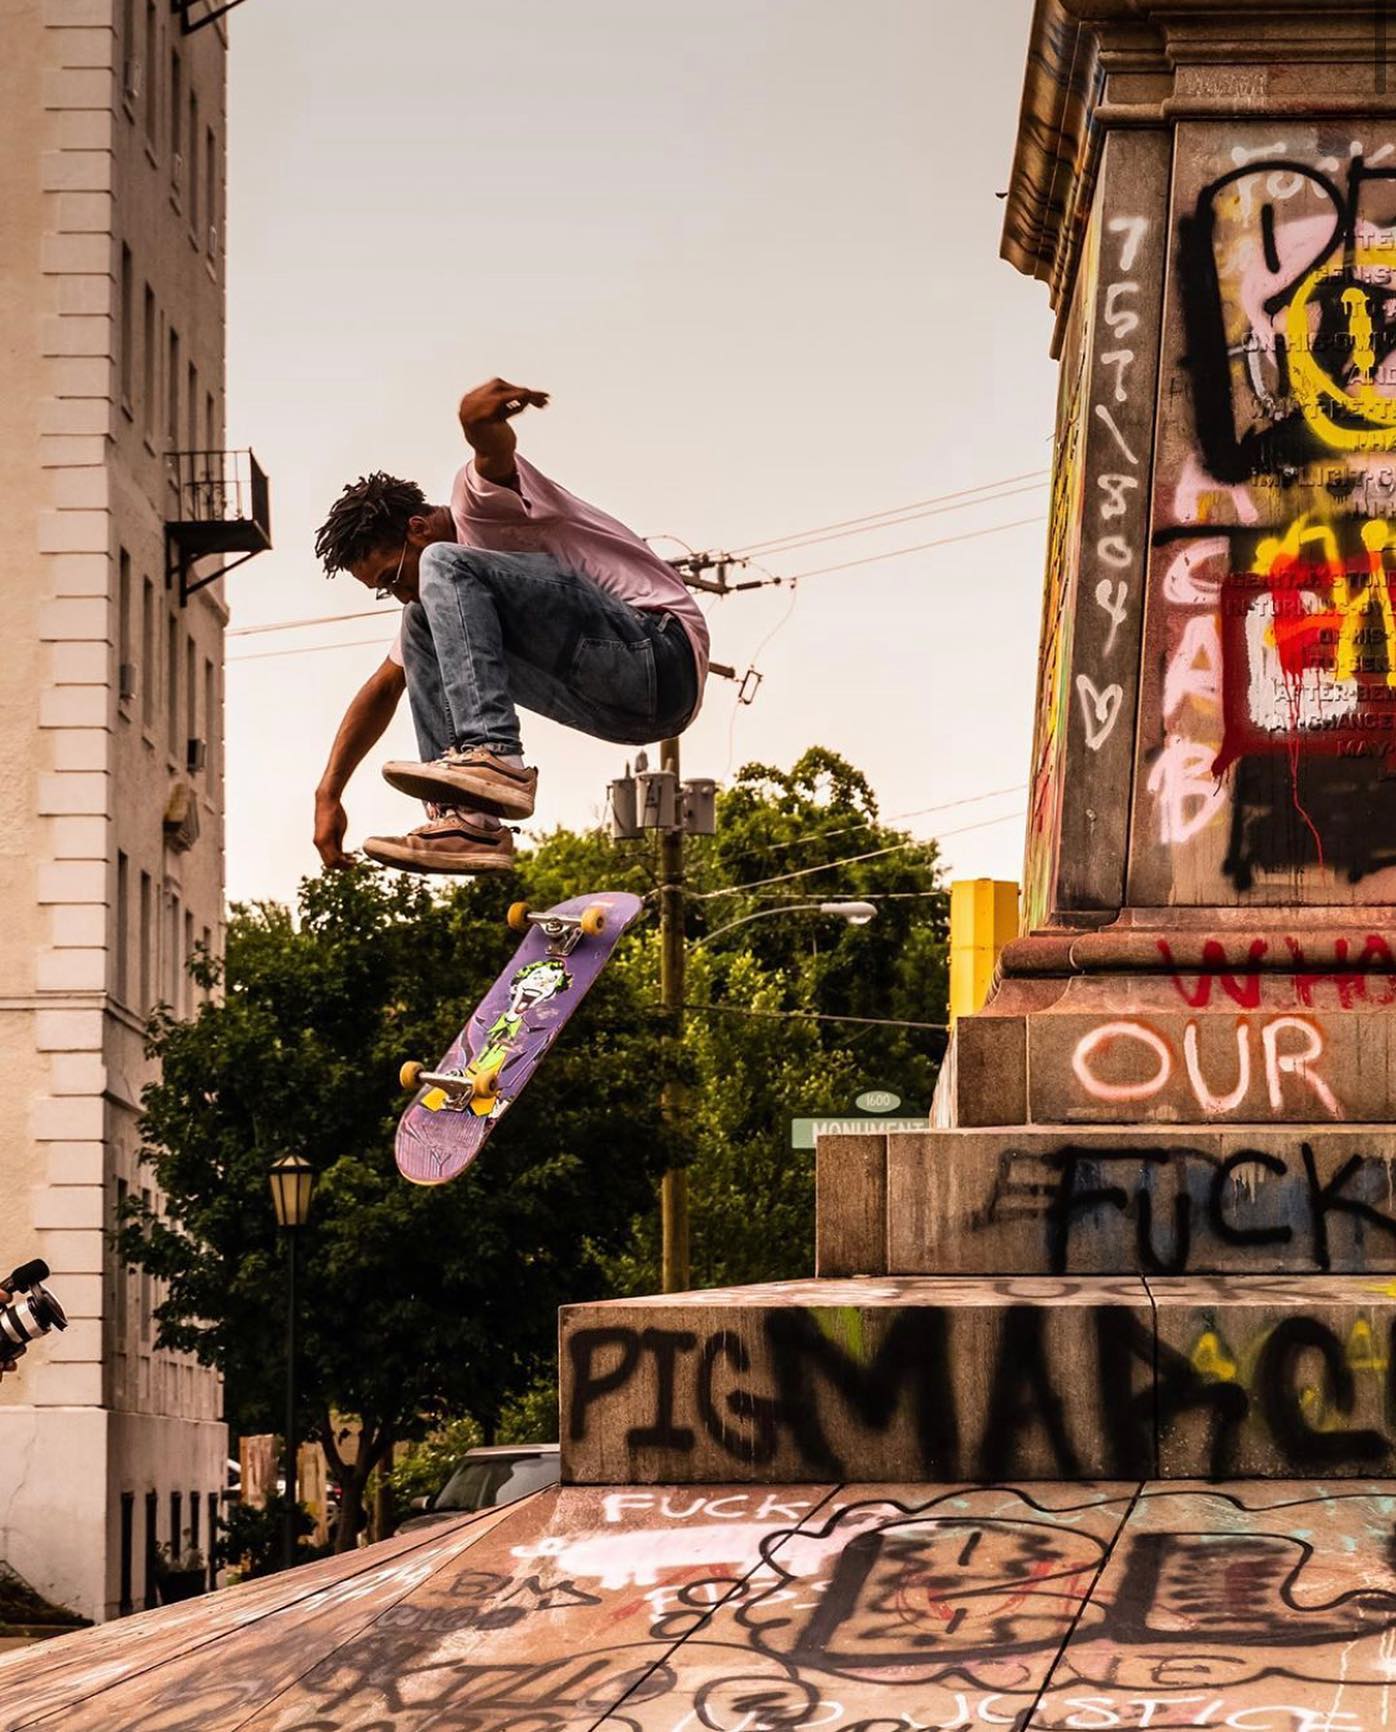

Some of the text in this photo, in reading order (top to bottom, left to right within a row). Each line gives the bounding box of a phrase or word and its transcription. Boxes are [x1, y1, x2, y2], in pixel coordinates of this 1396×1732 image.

[866, 1094, 890, 1106] 1600
[1072, 1017, 1344, 1120] OUR
[1043, 1142, 1396, 1275] FUCK
[601, 1493, 811, 1522] FUCK
